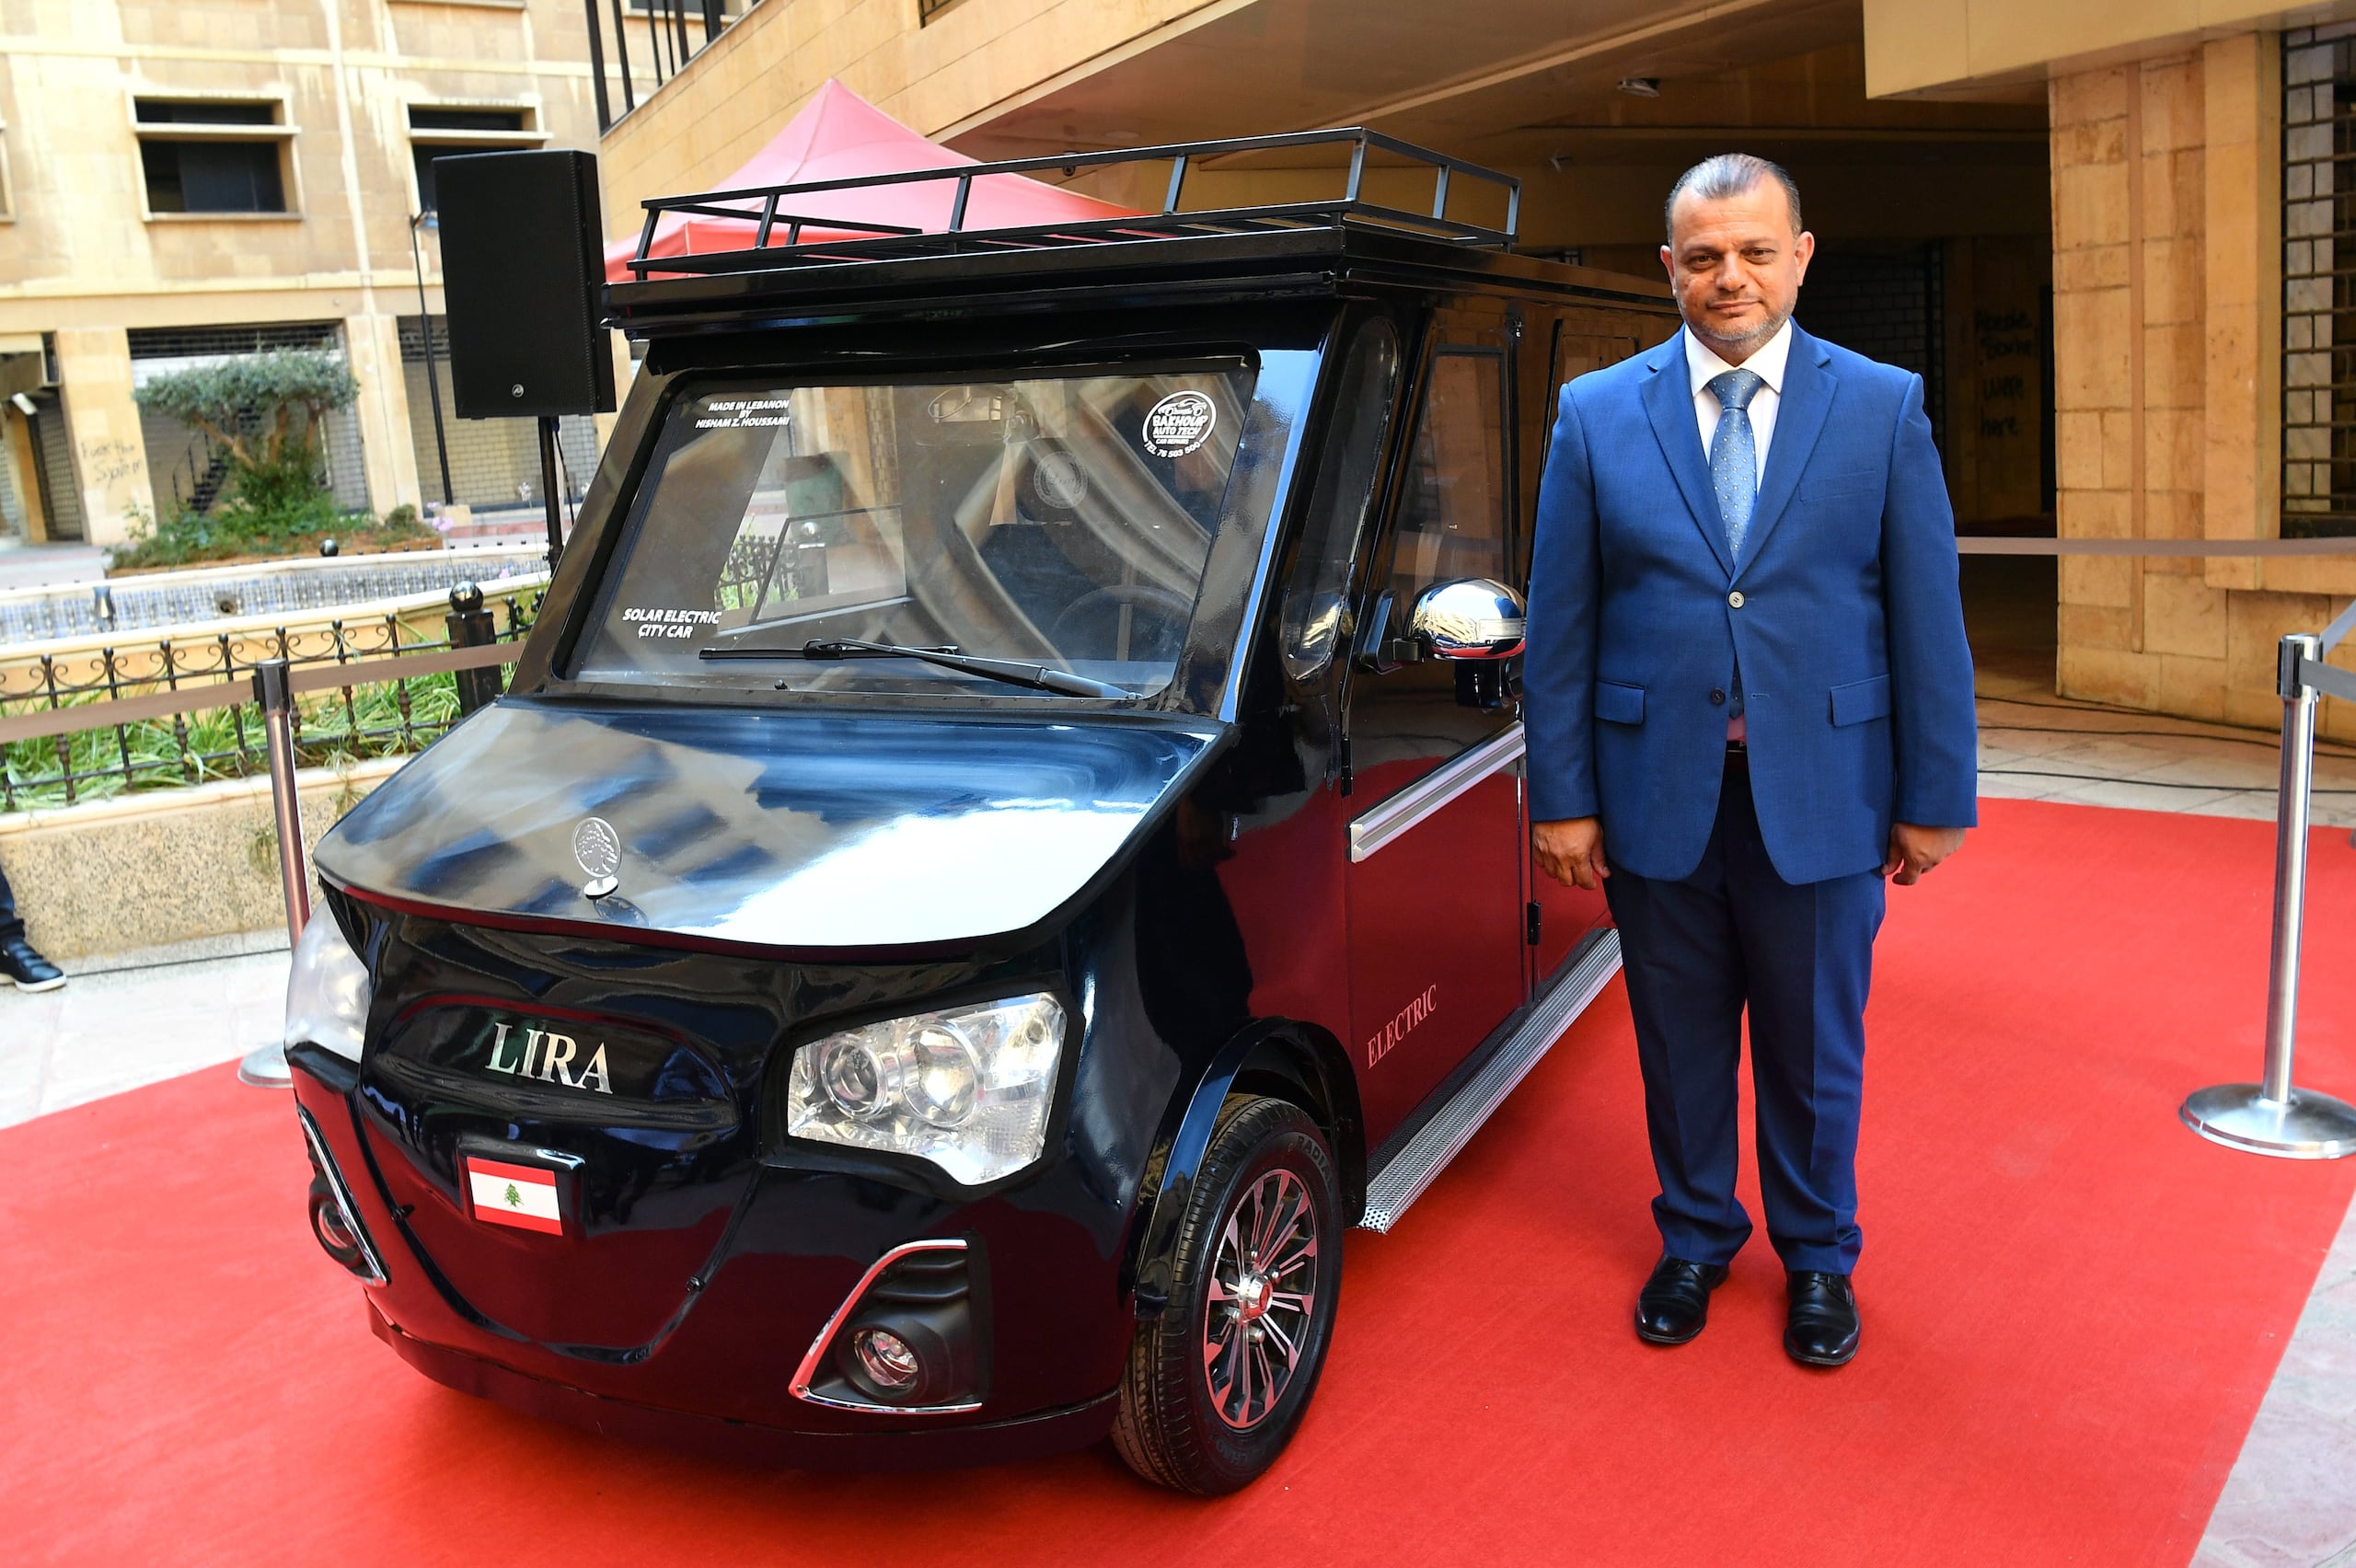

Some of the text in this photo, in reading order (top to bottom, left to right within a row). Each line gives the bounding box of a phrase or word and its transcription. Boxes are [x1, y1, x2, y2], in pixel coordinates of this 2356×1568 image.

[709, 400, 790, 411] MADE IN LEBANON
[738, 409, 752, 419] BY
[696, 419, 731, 428] HISHAM
[740, 417, 790, 427] HOUSSAMI
[1152, 415, 1208, 427] BAKHOUR
[1152, 426, 1202, 435] AUTO TECH
[1144, 441, 1158, 455] TEL
[622, 608, 722, 624] SOLAR ELECTRIC
[638, 624, 694, 639] CITY CAR
[1368, 983, 1437, 1070] ELECTRIC
[485, 1022, 614, 1095] LIRA
